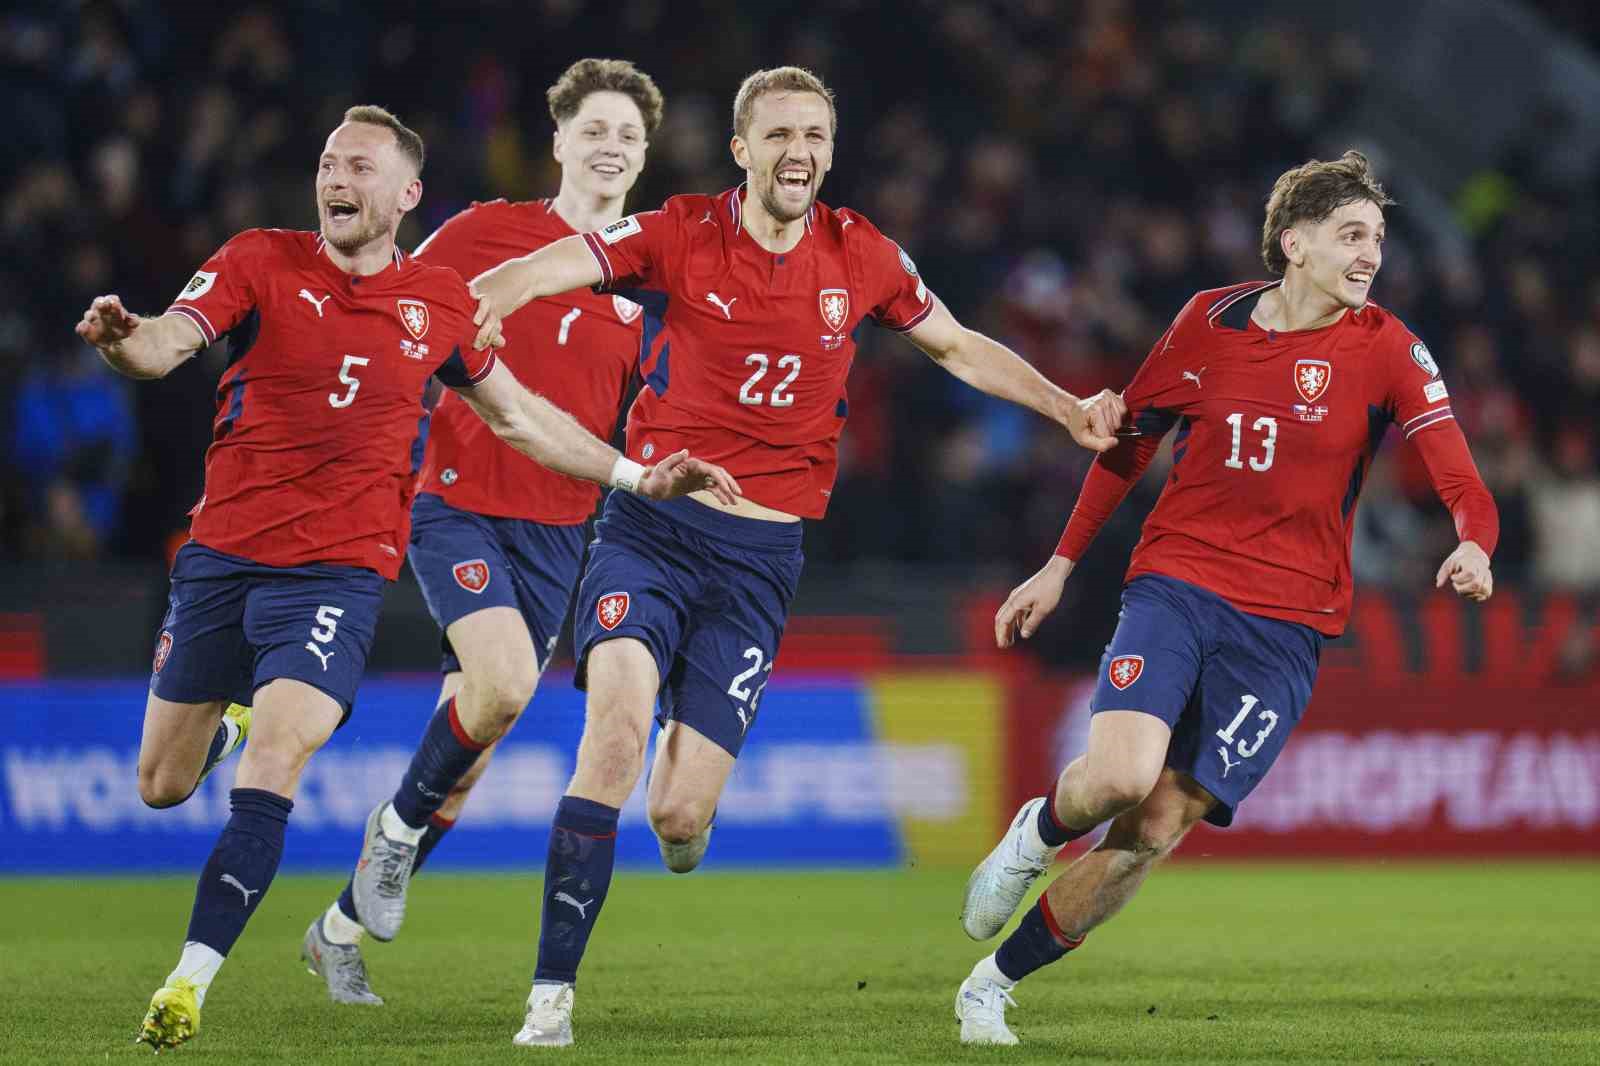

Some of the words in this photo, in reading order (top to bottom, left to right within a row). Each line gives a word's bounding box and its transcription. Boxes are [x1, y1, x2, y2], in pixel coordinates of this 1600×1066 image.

[328, 354, 371, 409] 5
[738, 353, 802, 408] 22
[1224, 412, 1279, 472] 13
[310, 605, 345, 644] 5
[1215, 693, 1280, 758] 13
